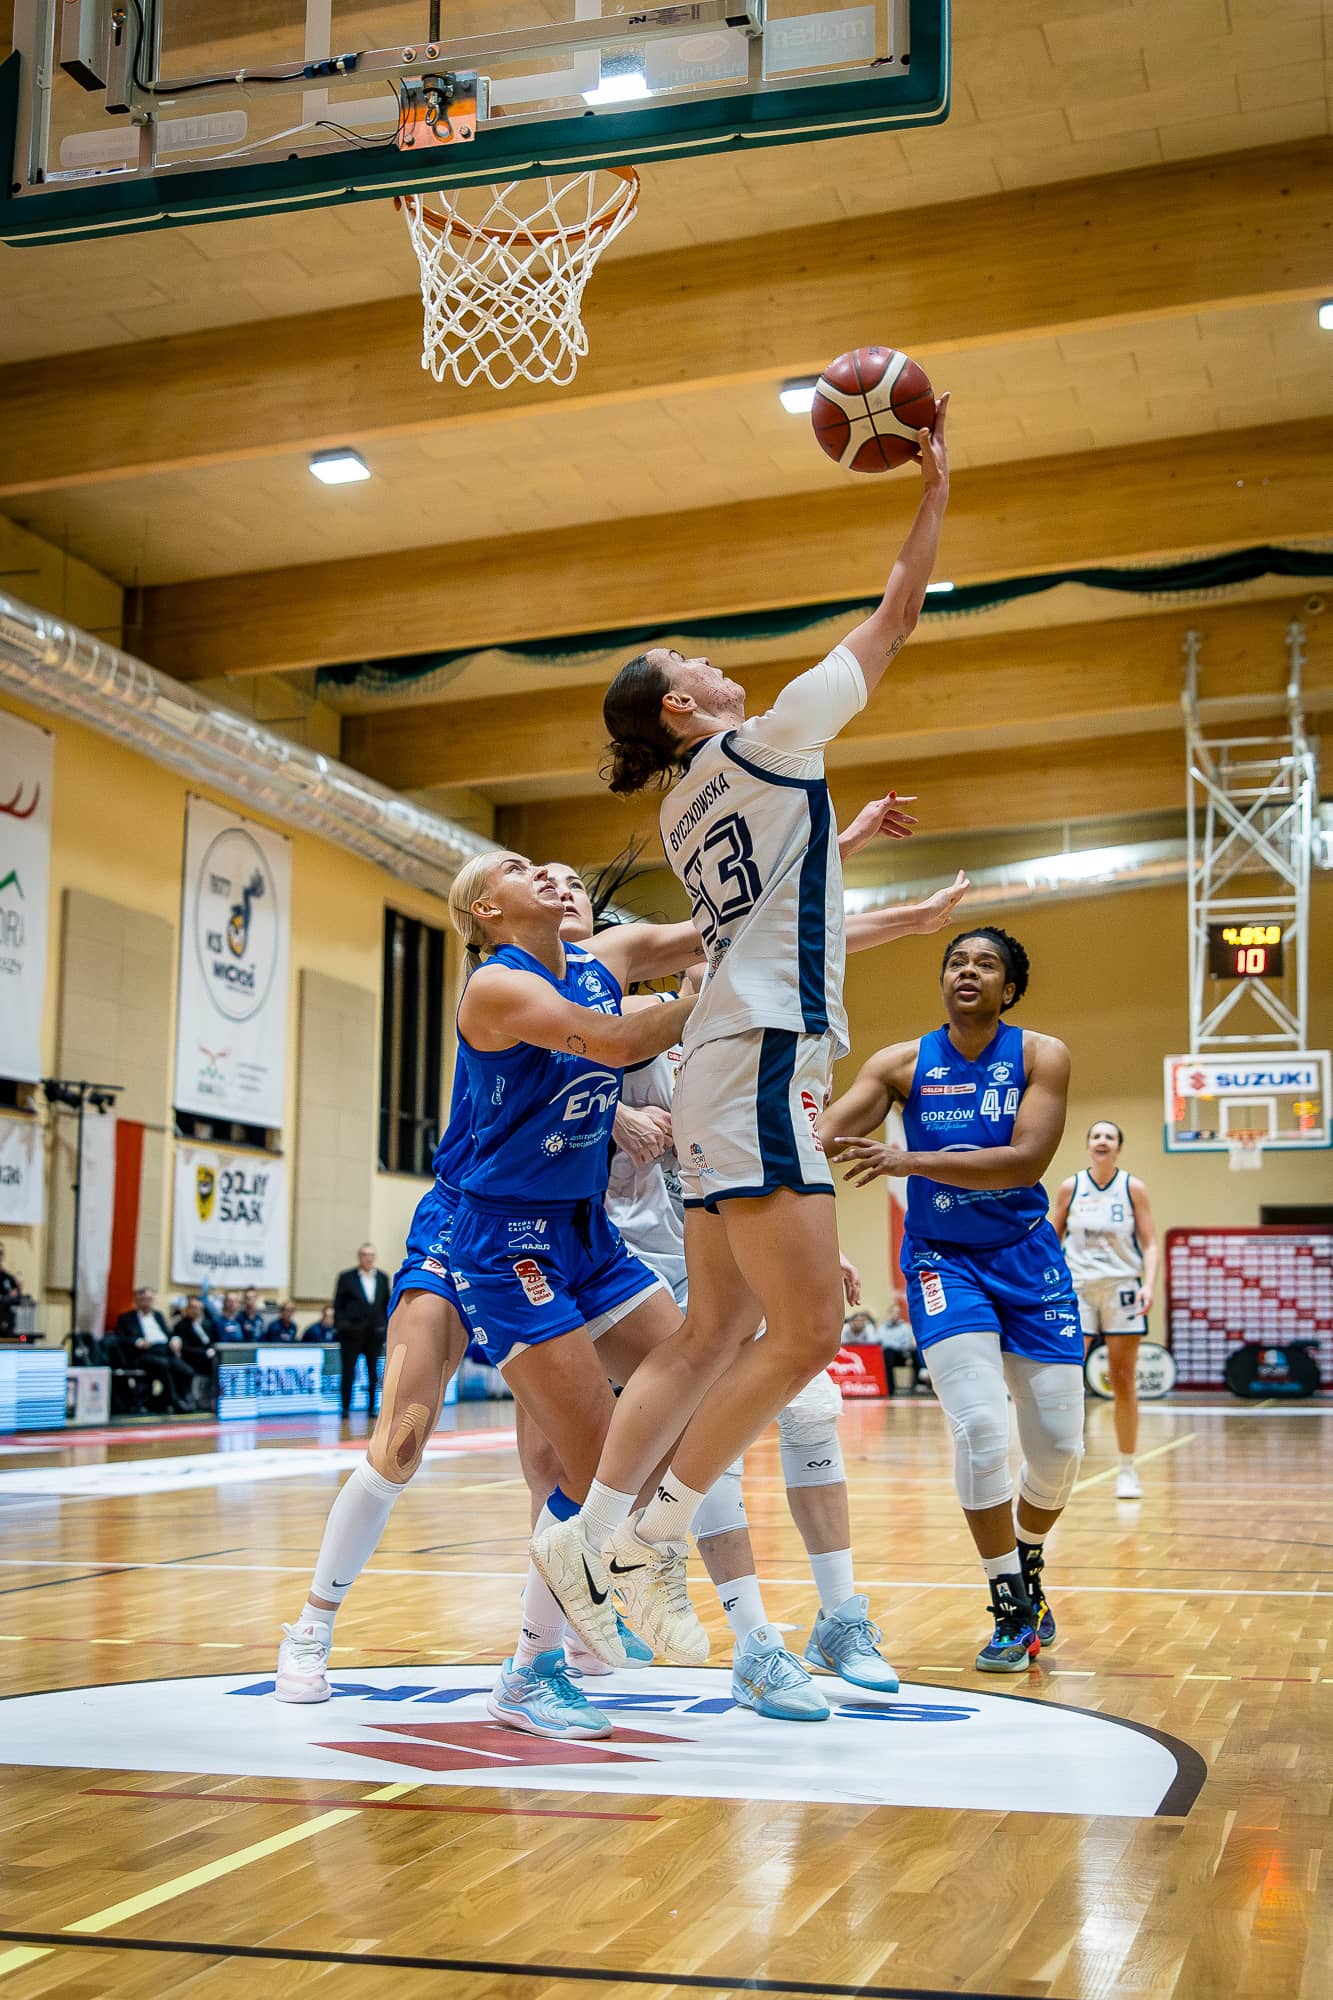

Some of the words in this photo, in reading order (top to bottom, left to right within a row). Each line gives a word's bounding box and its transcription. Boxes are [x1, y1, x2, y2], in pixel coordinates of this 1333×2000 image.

[670, 772, 731, 851] BYCZKOWSKA
[1237, 949, 1265, 973] 10
[926, 1066, 951, 1079] 4F
[1216, 1072, 1311, 1087] SUZUKI
[980, 1088, 1019, 1122] 44
[921, 1108, 975, 1122] GORZÓW
[1111, 1204, 1124, 1222] 8
[1059, 1325, 1077, 1337] 4F
